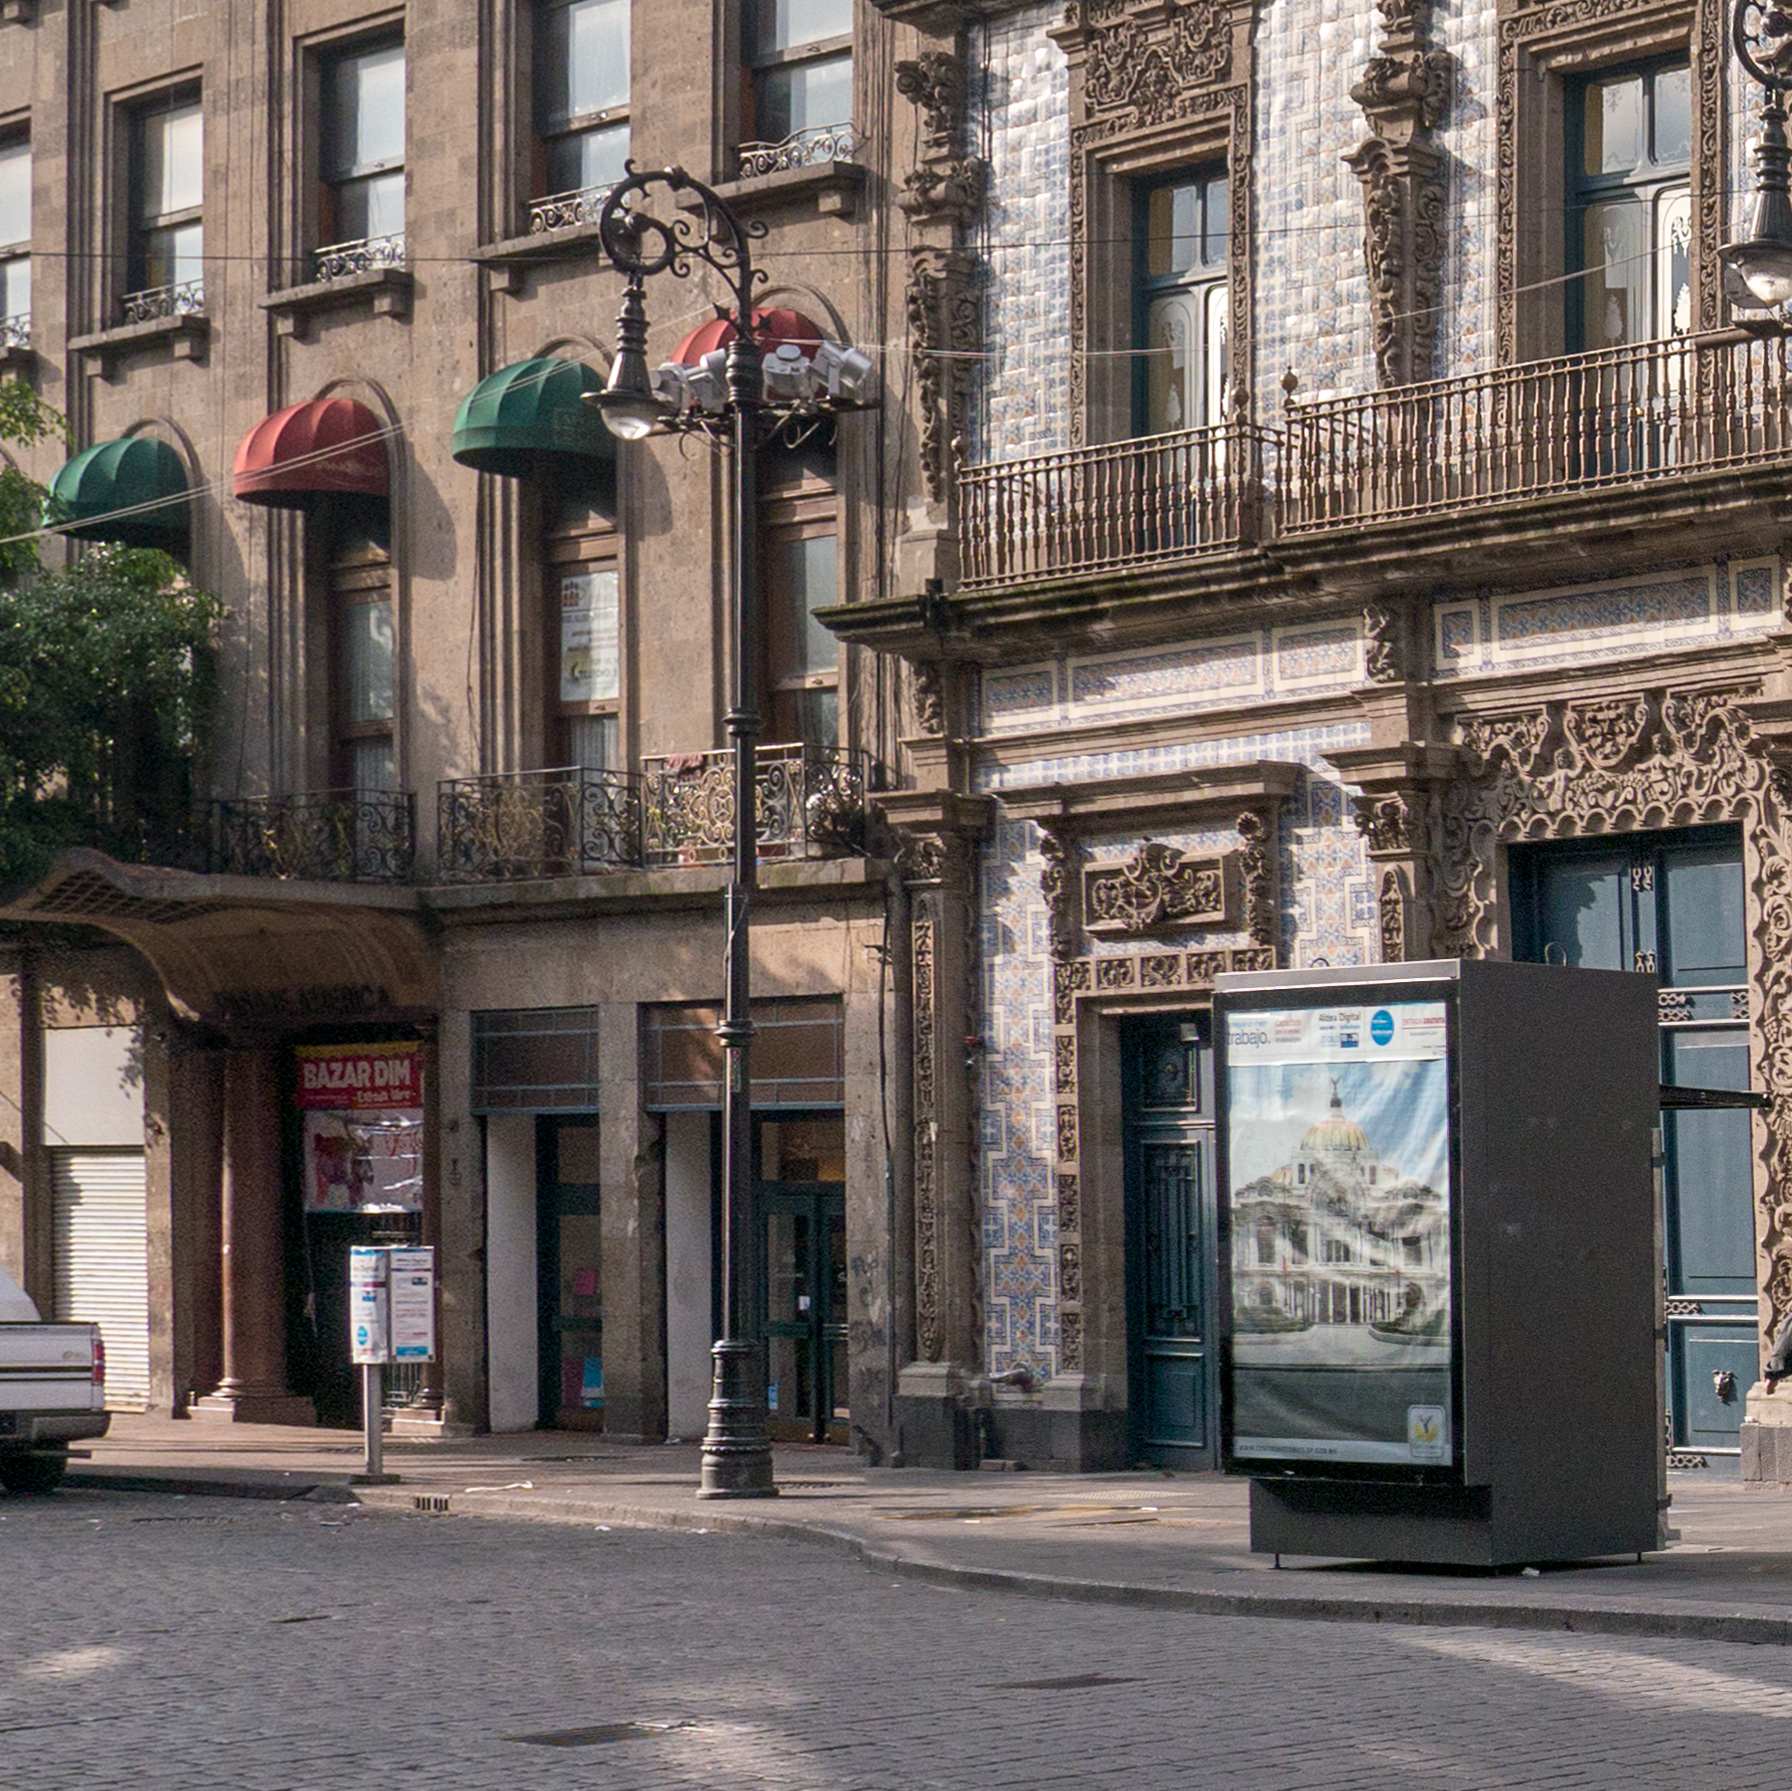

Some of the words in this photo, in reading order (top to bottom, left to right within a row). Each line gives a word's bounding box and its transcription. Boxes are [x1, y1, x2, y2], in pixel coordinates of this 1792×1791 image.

[1318, 1013, 1337, 1022] Aldea
[1339, 1012, 1361, 1023] Digital
[303, 1061, 371, 1089] BAZAR
[373, 1059, 411, 1087] DIM
